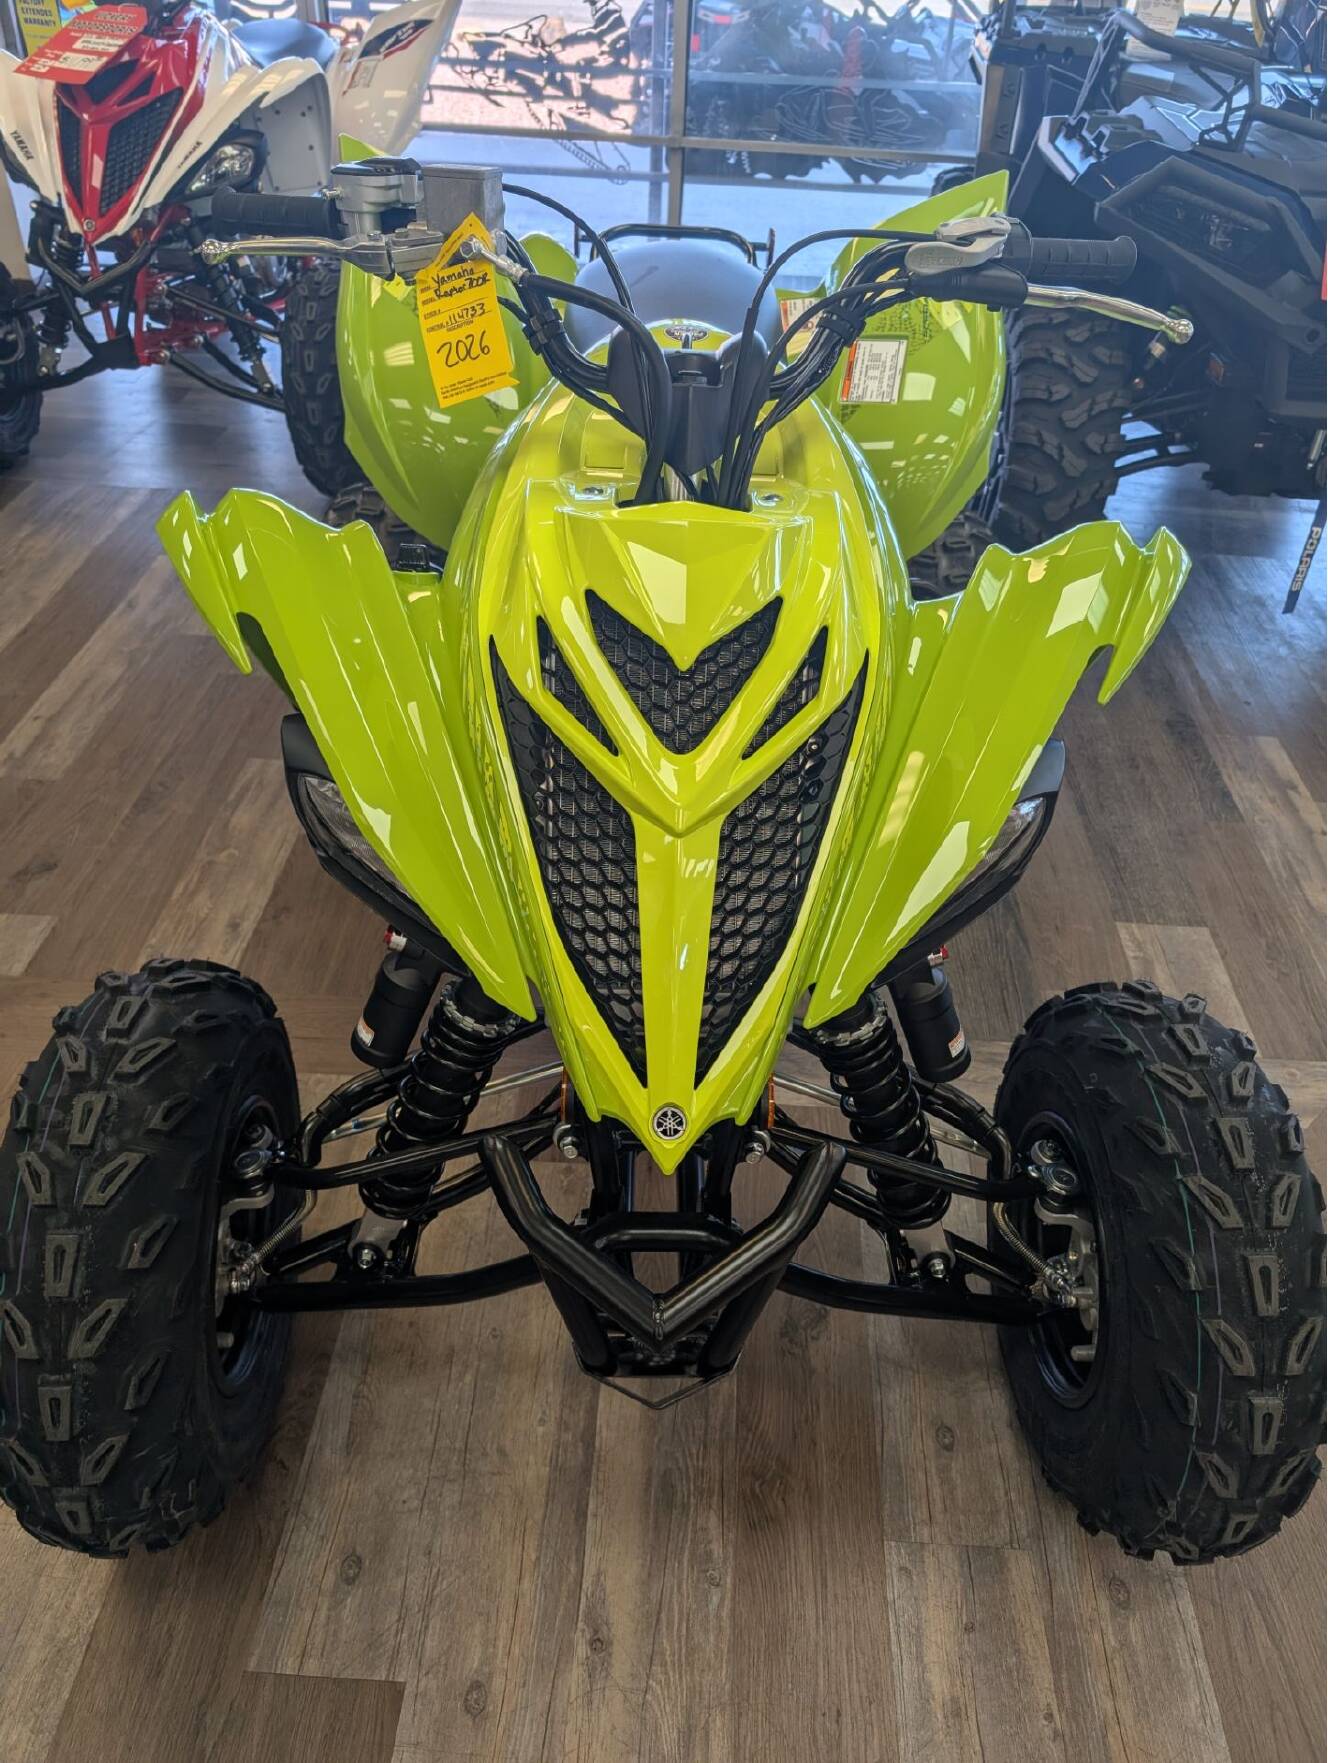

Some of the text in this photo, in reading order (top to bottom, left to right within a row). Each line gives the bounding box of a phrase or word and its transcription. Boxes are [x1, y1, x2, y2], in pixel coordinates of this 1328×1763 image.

[21, 7, 53, 17] EXTENDED
[24, 18, 56, 27] WARRANTY
[10, 130, 35, 160] YAMAHA
[431, 265, 474, 289] Yamaha
[448, 303, 485, 325] 114733
[436, 330, 490, 368] 2026
[1292, 527, 1322, 592] POLARIS
